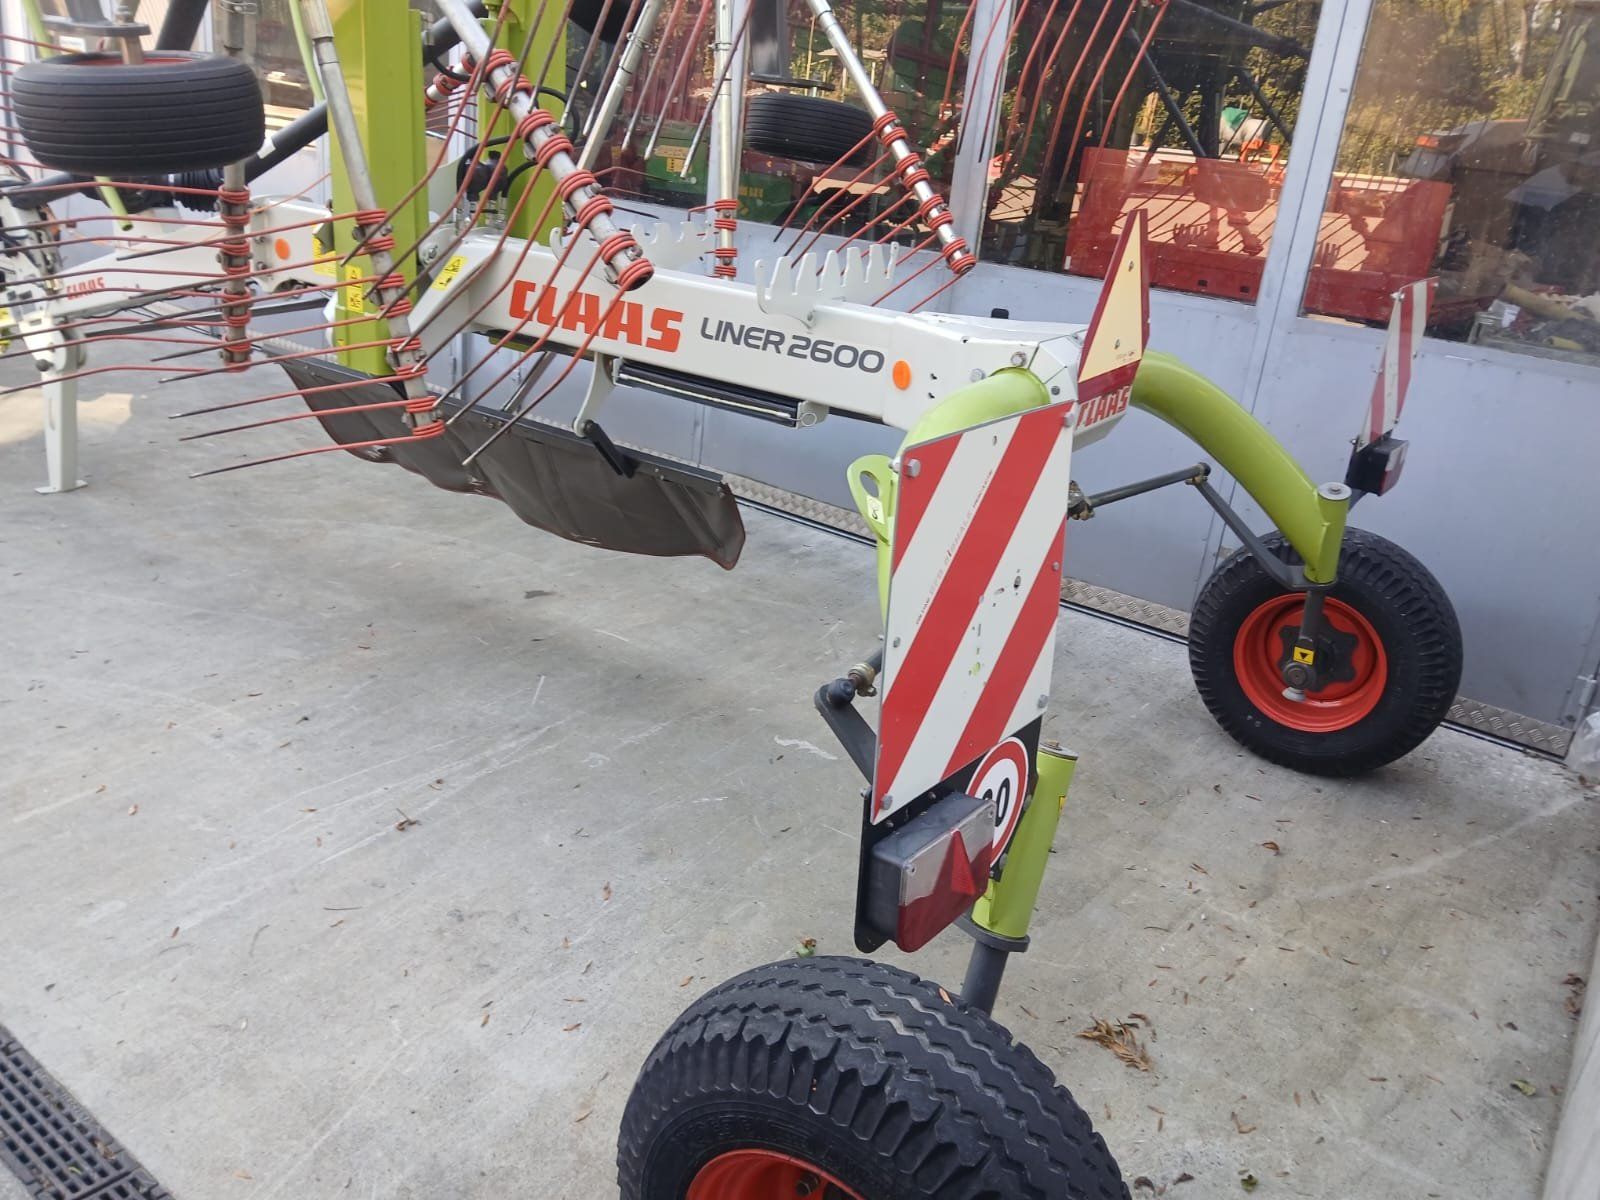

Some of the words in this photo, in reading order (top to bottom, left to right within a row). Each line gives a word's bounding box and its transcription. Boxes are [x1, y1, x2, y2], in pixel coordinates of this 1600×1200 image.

[508, 279, 685, 353] CLAAS
[699, 317, 786, 354] LINER
[787, 334, 885, 374] 2600
